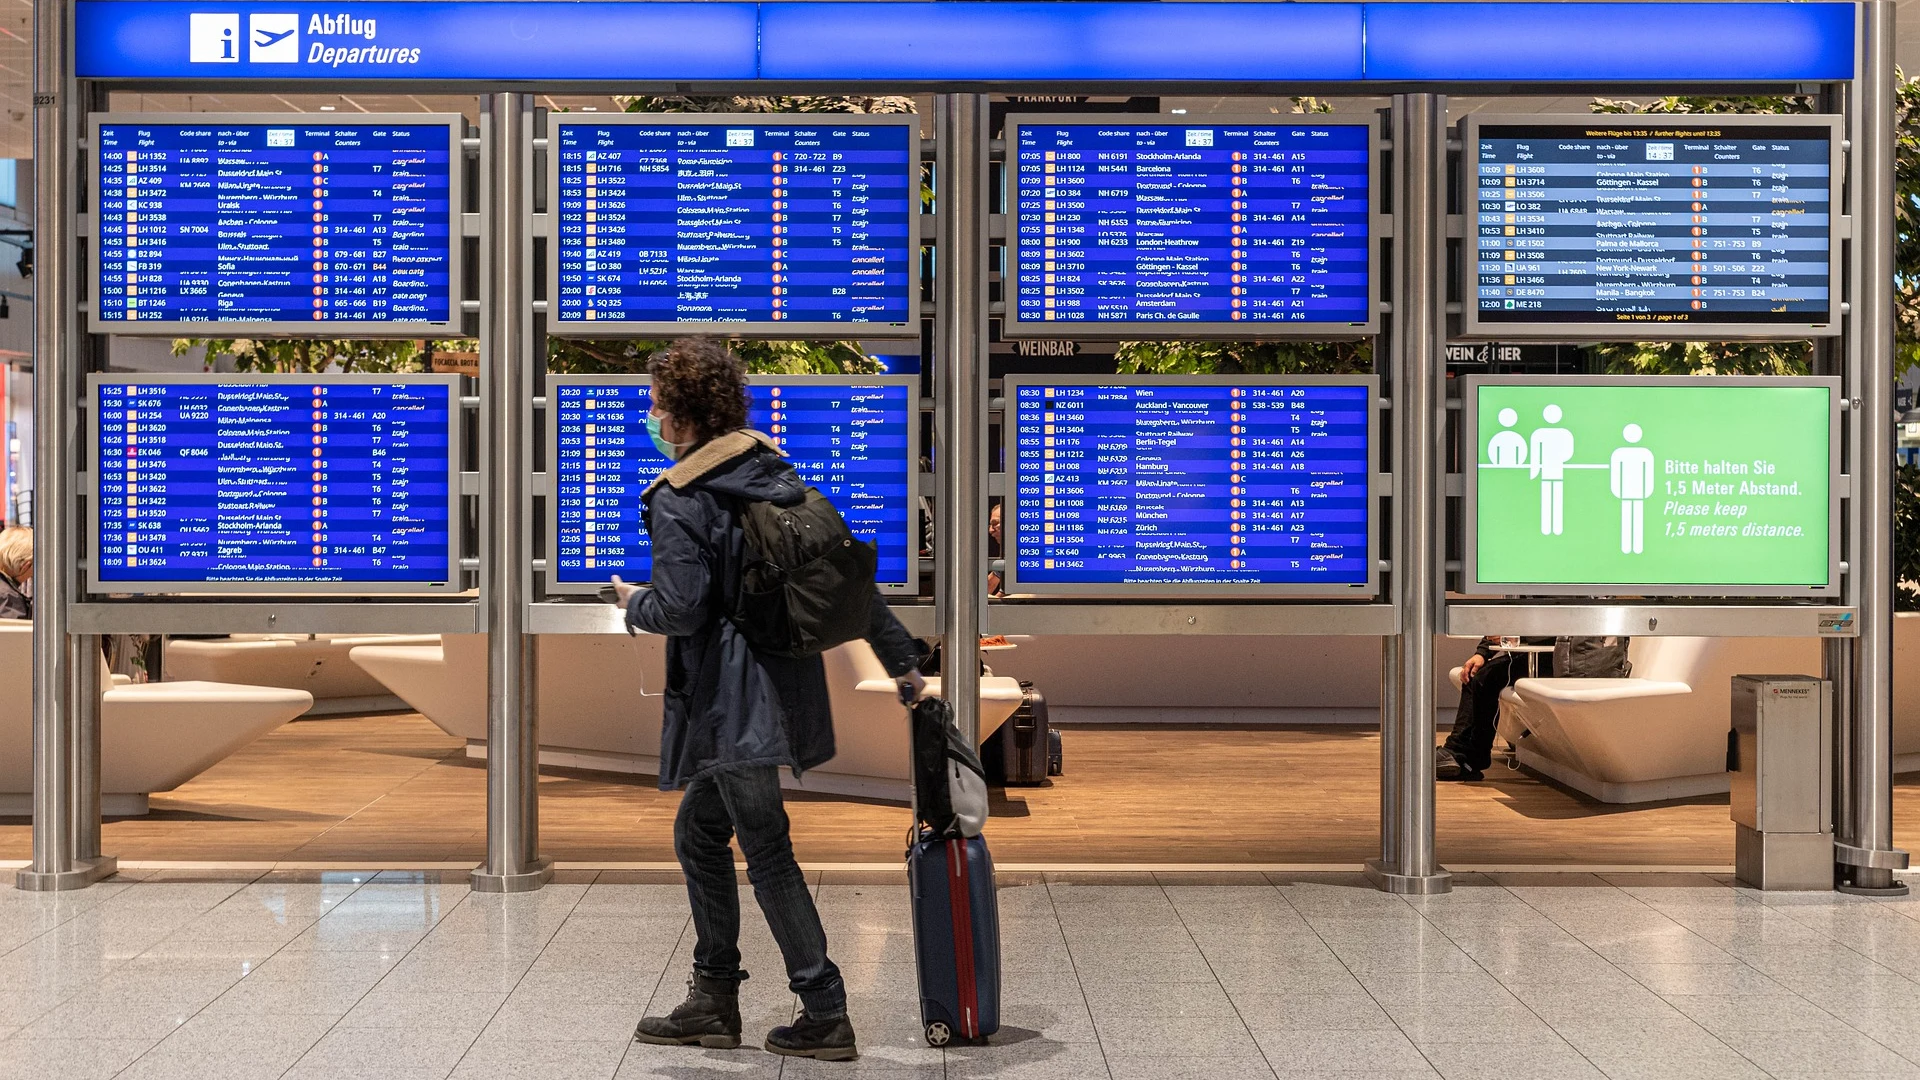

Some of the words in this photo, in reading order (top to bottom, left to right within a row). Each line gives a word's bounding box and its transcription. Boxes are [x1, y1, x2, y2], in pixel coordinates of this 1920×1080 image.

[308, 14, 376, 39] Abflug
[308, 42, 420, 68] Departures
[104, 152, 122, 160] 14:00
[150, 152, 167, 160] 1352
[1596, 179, 1631, 187] Göttingen
[218, 299, 233, 308] Riga
[1019, 341, 1074, 356] WEINBAR
[596, 389, 604, 397] JU
[1136, 439, 1176, 447] Berlin-Tegel
[1136, 463, 1169, 471] Hamburg
[1665, 460, 1699, 474] Bitte
[1704, 460, 1748, 474] halten
[1753, 460, 1776, 474] Sie
[1665, 481, 1686, 496] 1,5
[1692, 480, 1735, 495] Meter
[1739, 481, 1802, 496] Abstand.
[1664, 501, 1710, 516] Please
[1714, 502, 1748, 519] keep
[1665, 522, 1687, 538] 1,5
[1689, 523, 1738, 537] meters
[1742, 523, 1805, 537] distance.
[104, 546, 122, 554] 18:00
[218, 546, 242, 555] Zagreb
